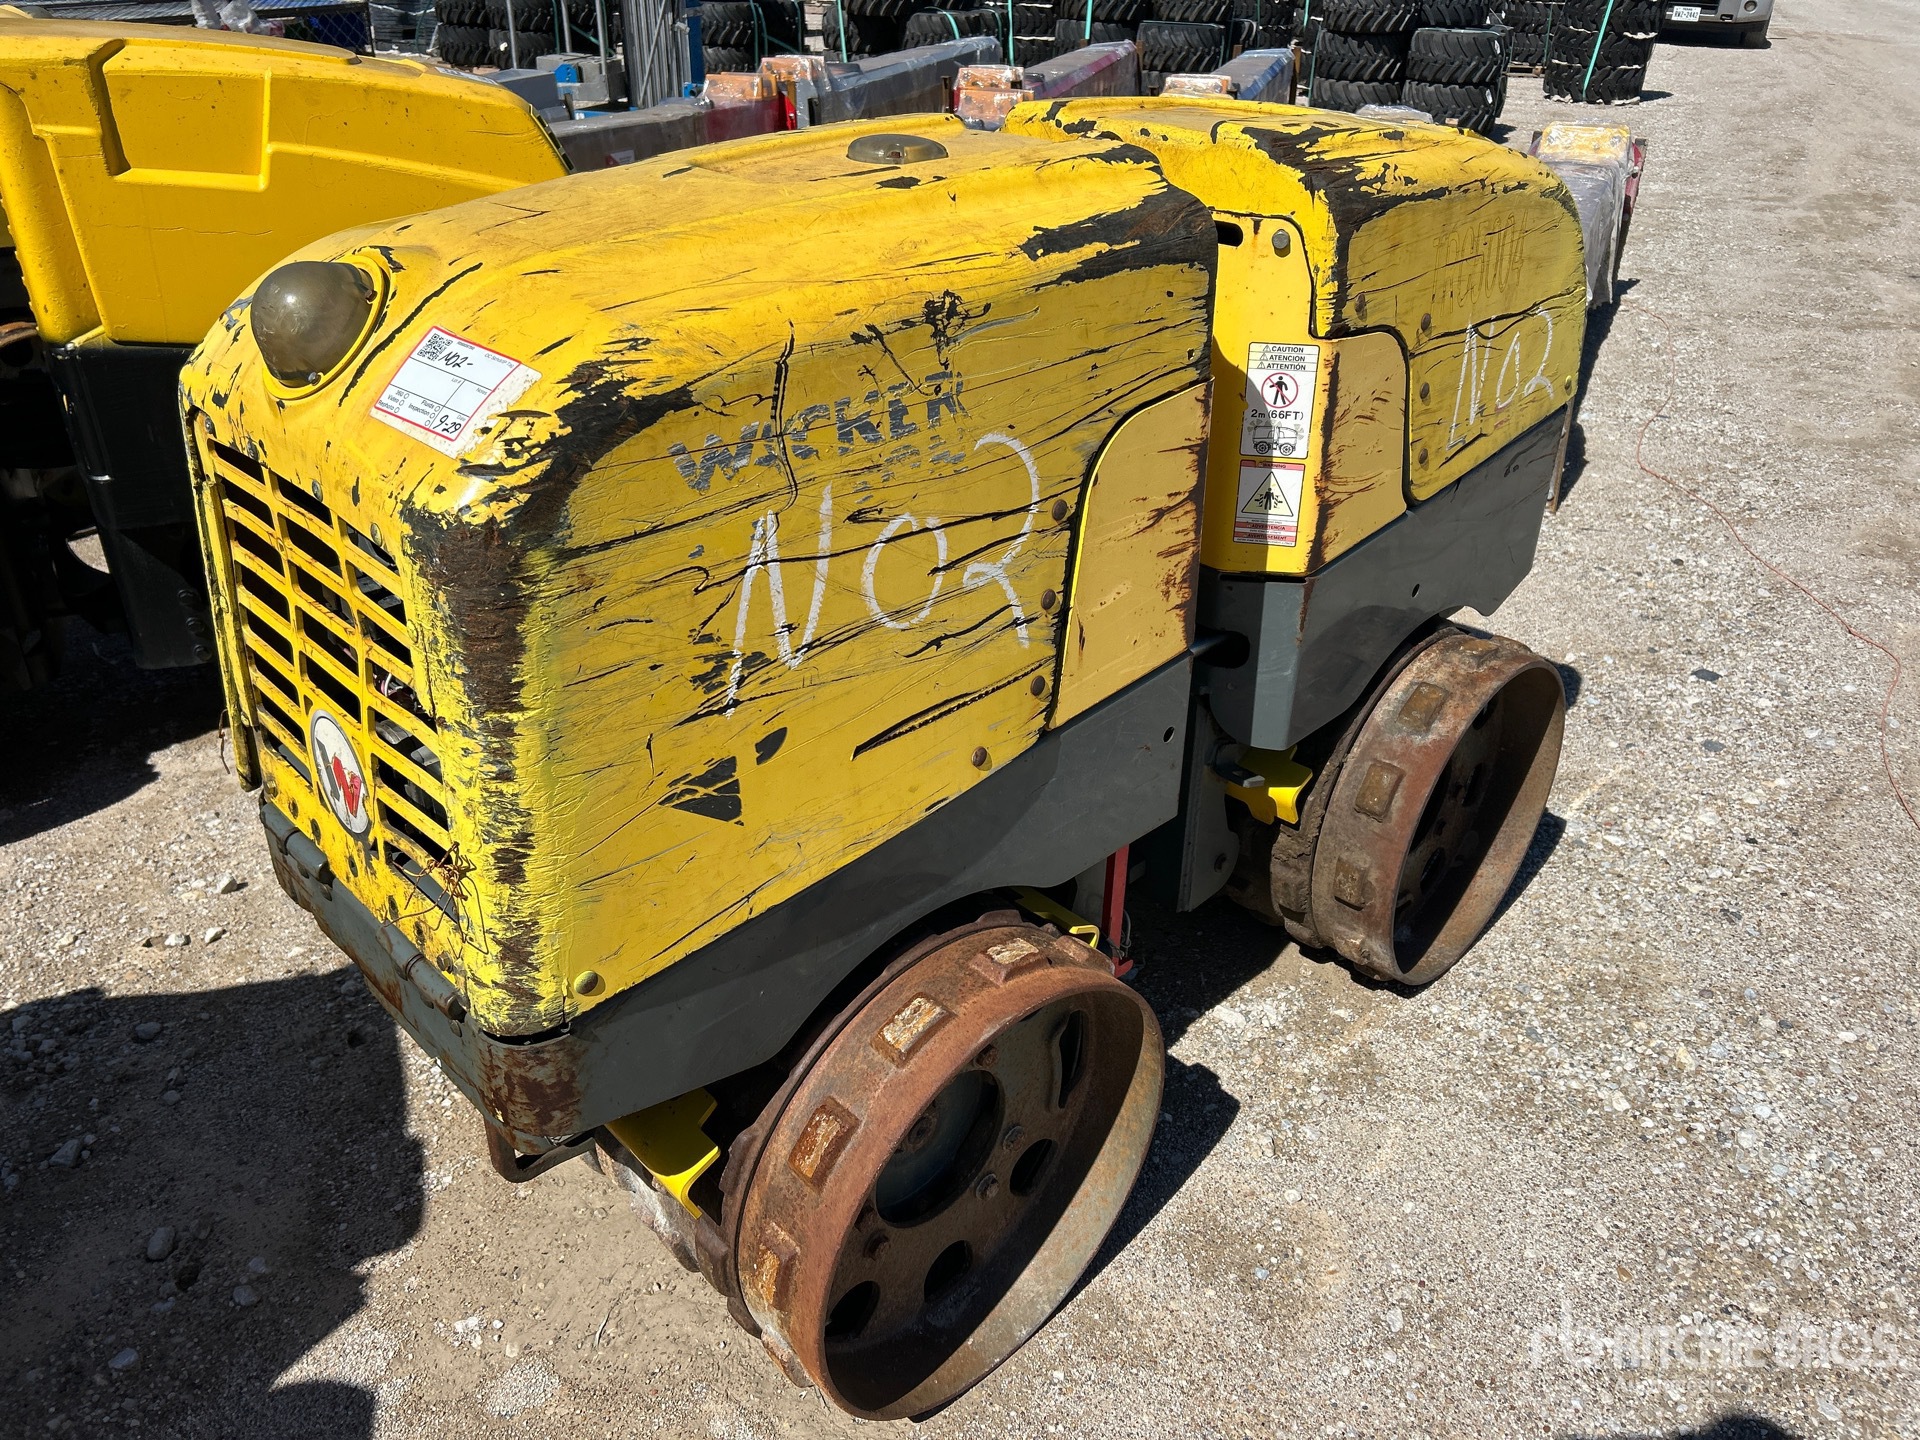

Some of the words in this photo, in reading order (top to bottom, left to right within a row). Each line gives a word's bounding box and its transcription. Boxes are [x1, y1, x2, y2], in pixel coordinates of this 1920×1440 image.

[1271, 345, 1304, 353] CAUTION
[387, 394, 400, 404] Video
[408, 403, 431, 417] Inspection
[420, 400, 435, 410] Fluids
[1250, 408, 1266, 419] 2m
